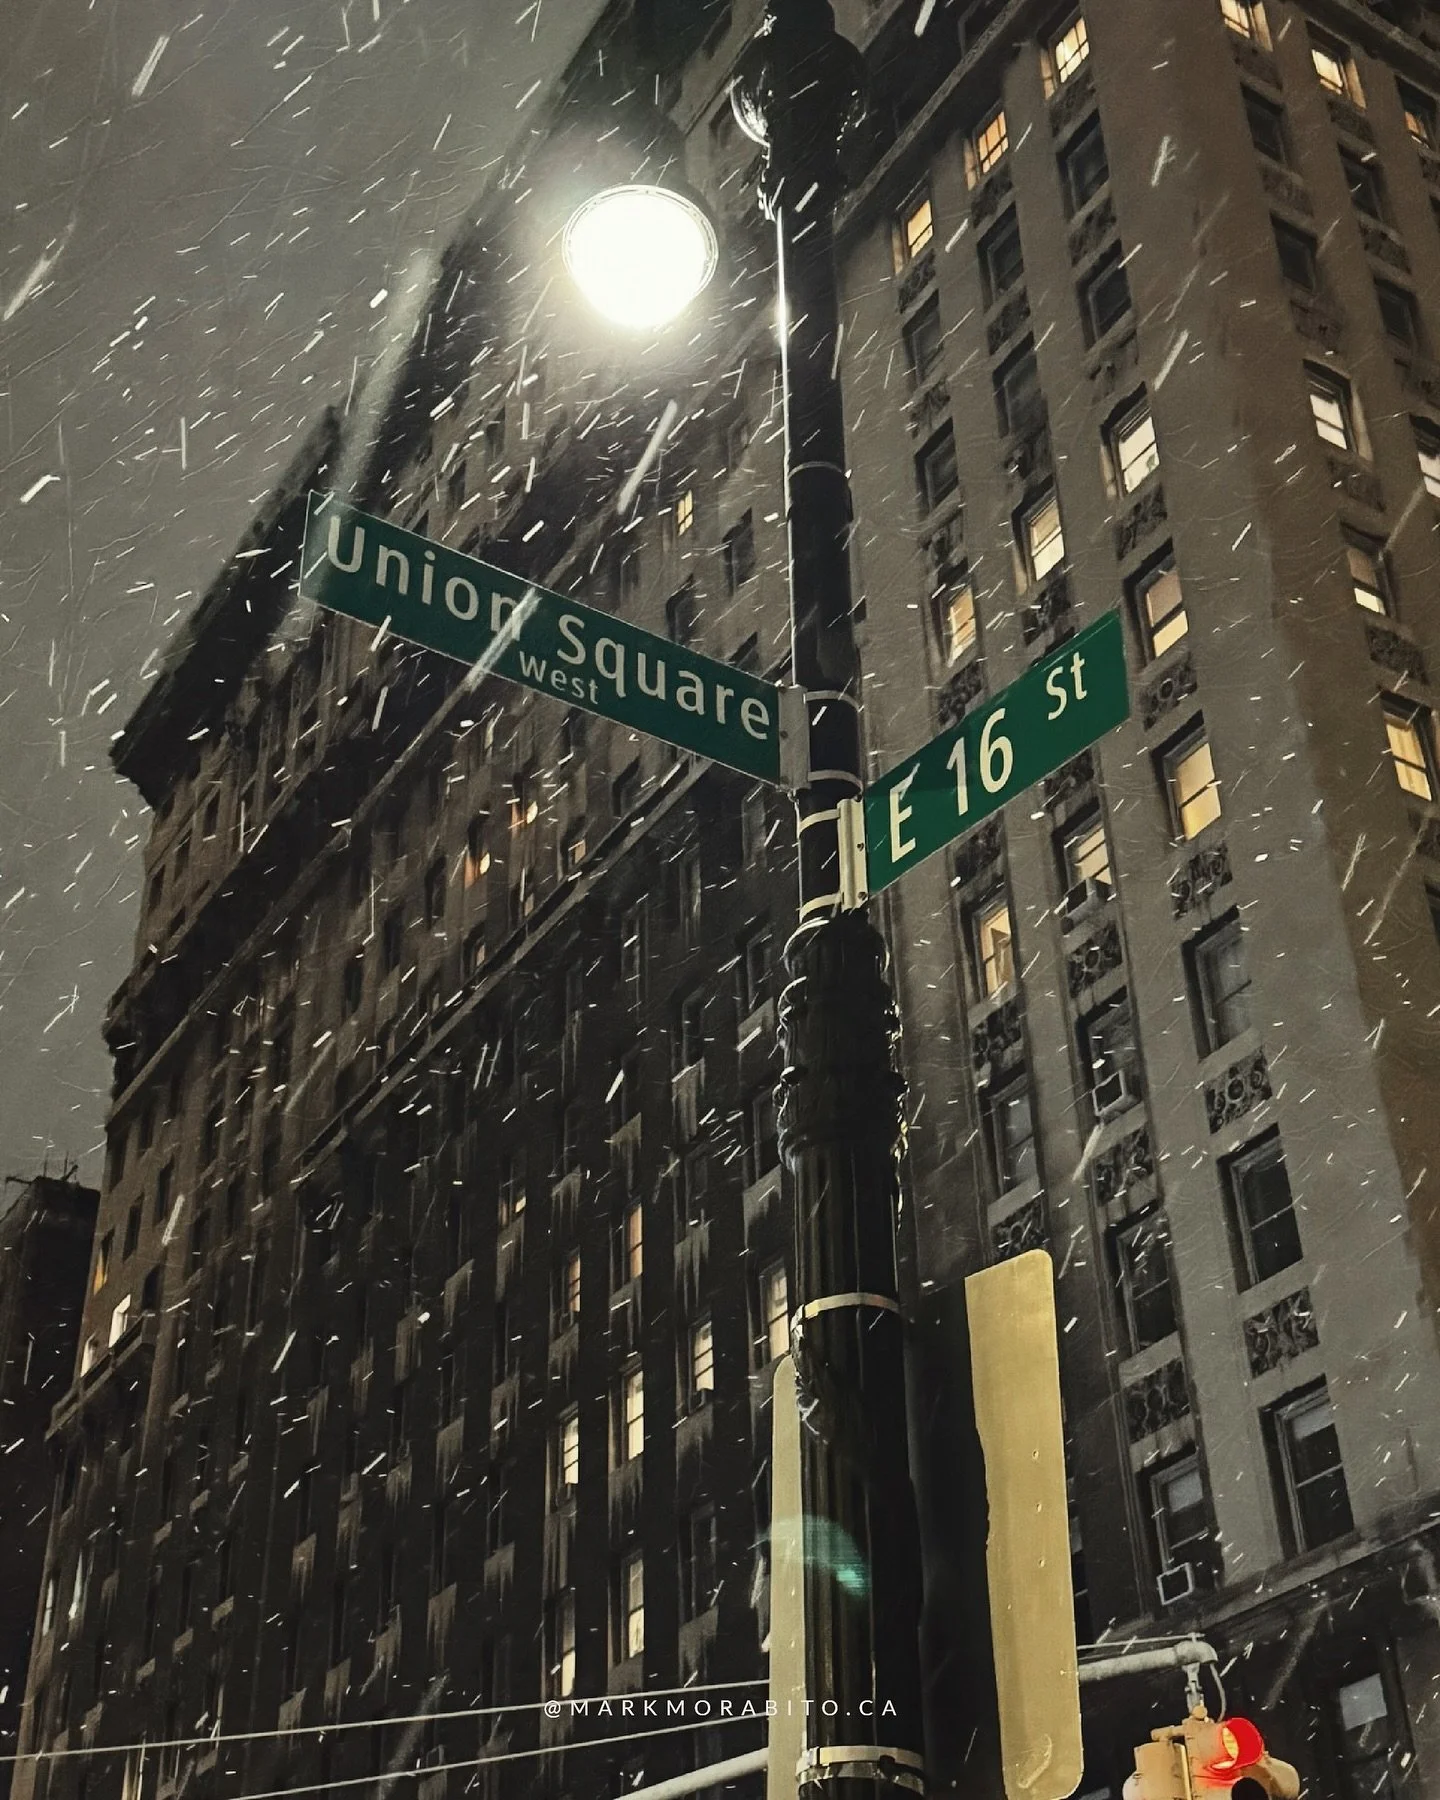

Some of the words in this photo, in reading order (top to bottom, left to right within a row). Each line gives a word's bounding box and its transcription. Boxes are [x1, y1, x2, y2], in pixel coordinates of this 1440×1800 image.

[327, 515, 521, 641] Union
[557, 614, 770, 740] Square
[890, 763, 920, 863] E
[946, 707, 1014, 816] 16
[1045, 651, 1088, 720] St
